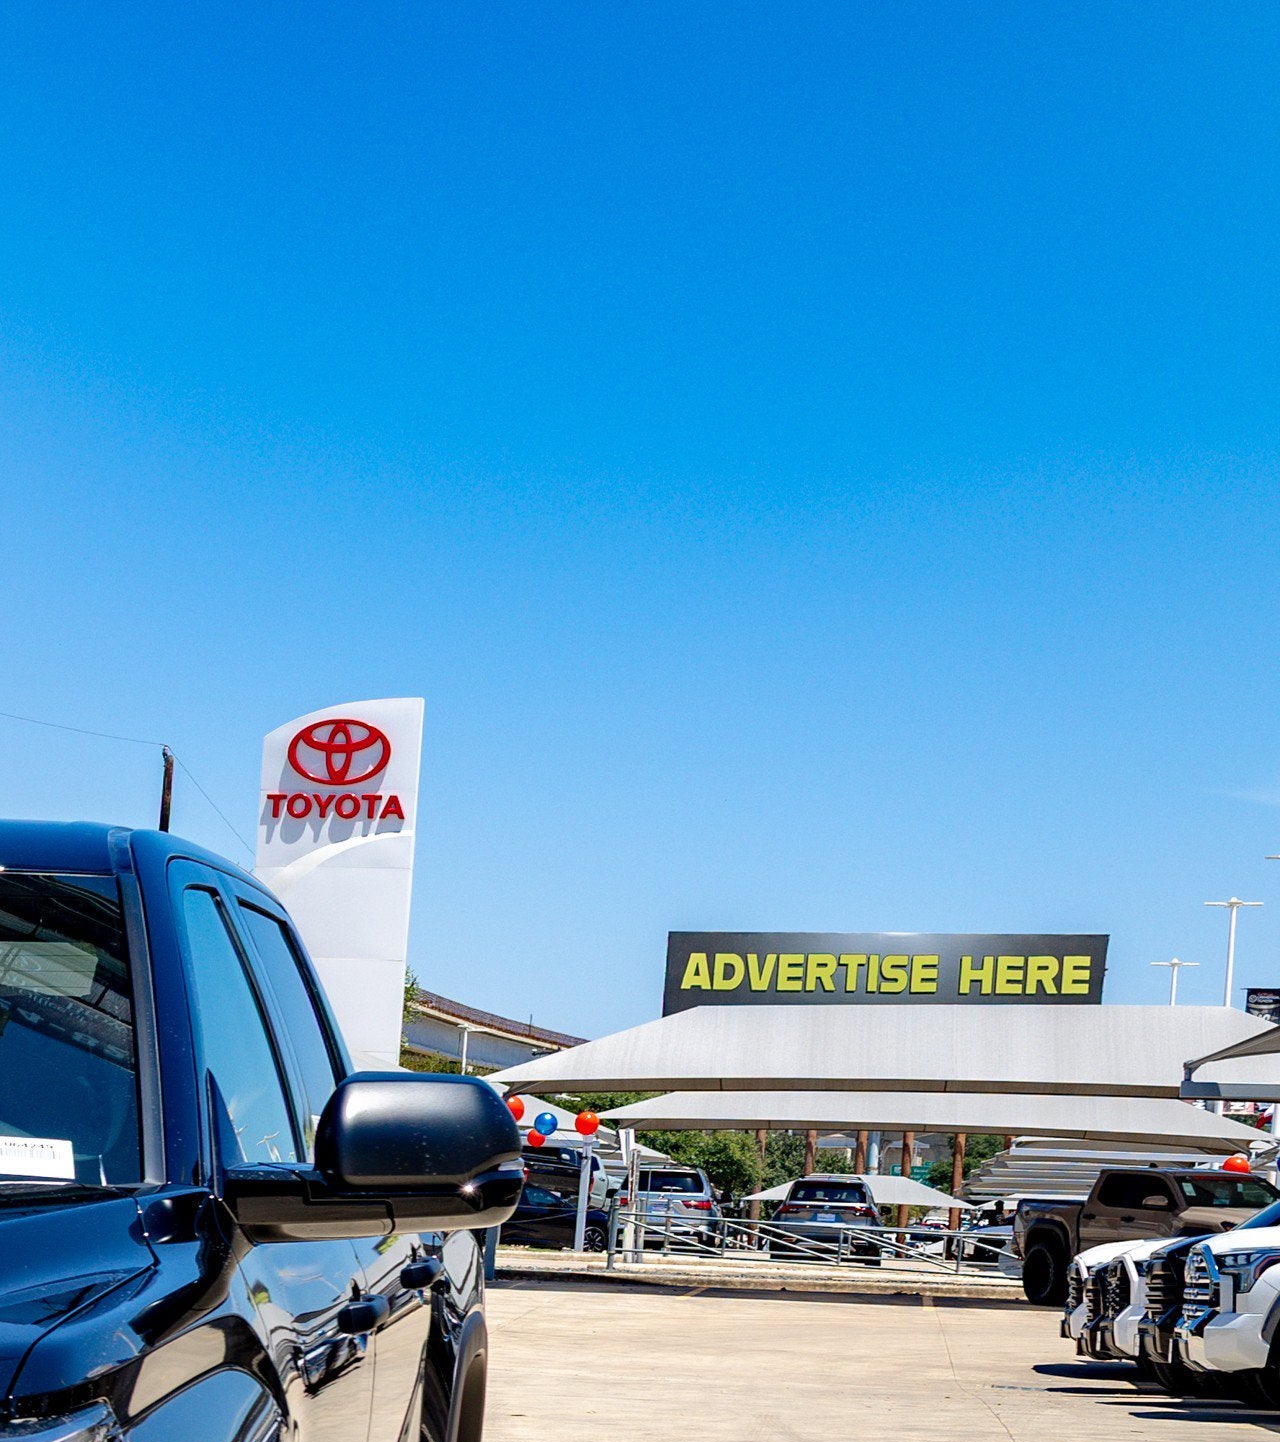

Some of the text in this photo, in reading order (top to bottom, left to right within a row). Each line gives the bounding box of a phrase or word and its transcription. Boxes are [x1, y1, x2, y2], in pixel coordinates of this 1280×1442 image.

[266, 793, 405, 820] TOYOTA
[680, 952, 1092, 996] ADVERTISE HERE
